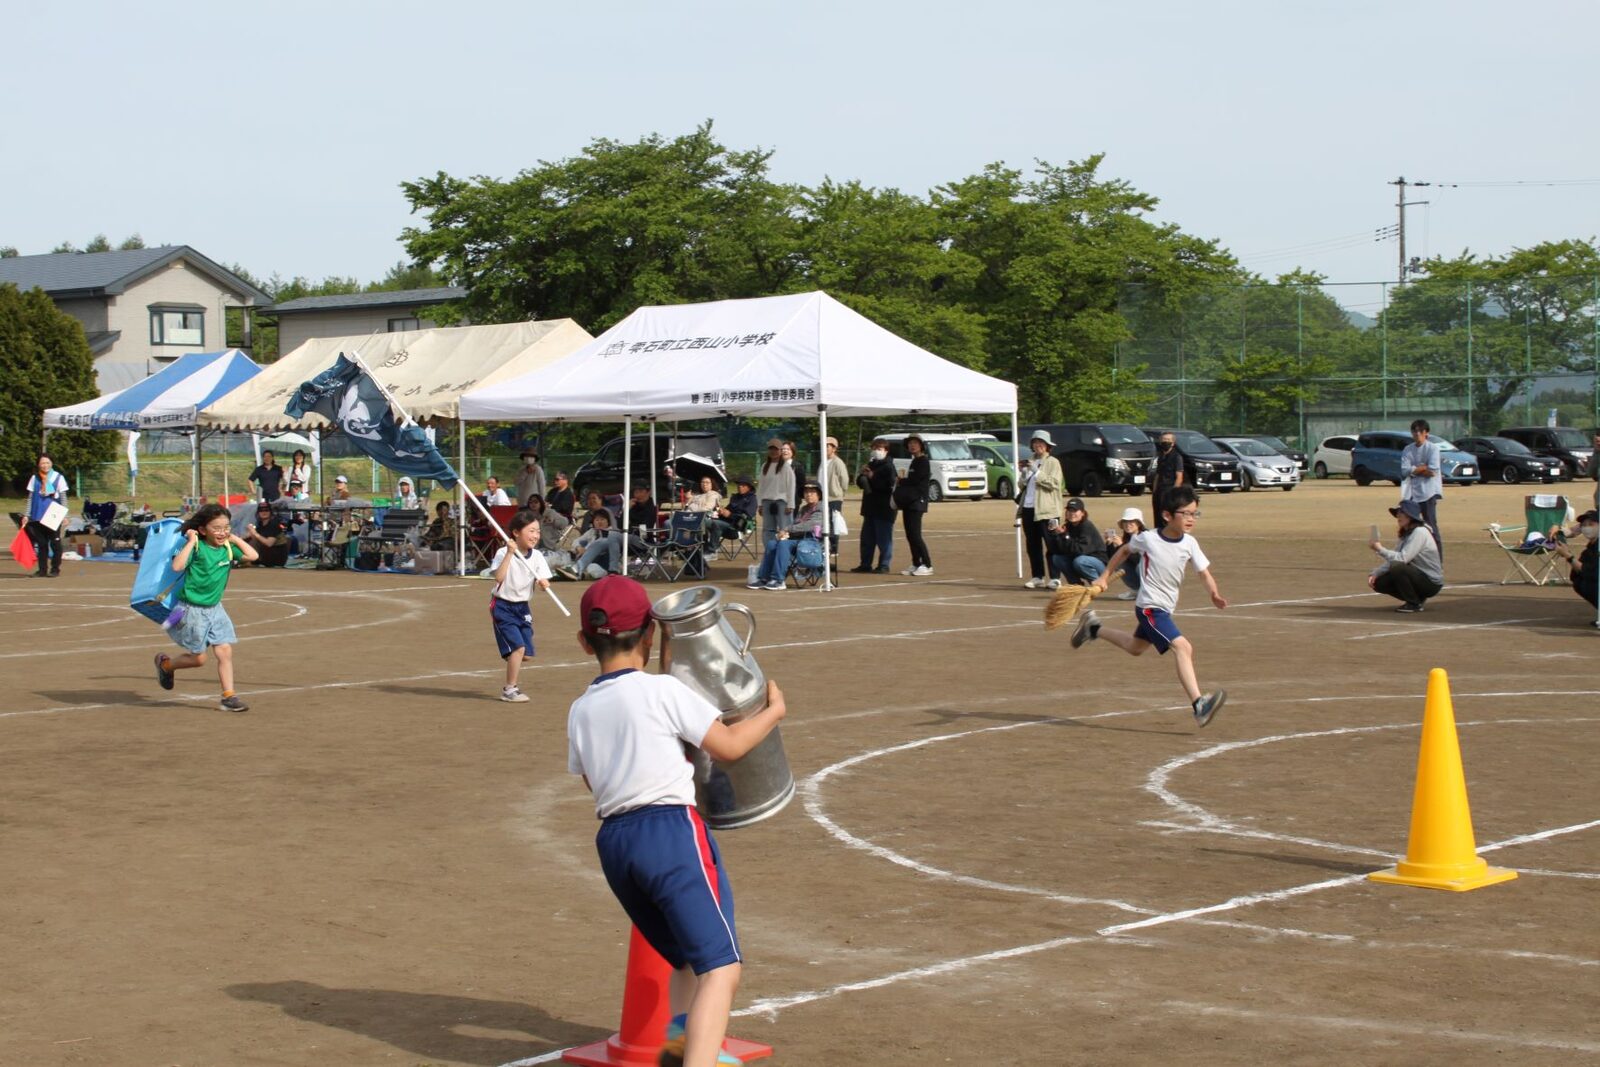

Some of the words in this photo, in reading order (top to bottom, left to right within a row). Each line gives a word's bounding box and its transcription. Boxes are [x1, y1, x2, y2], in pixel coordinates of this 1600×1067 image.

[628, 332, 777, 354] 雫石町立西山小学校
